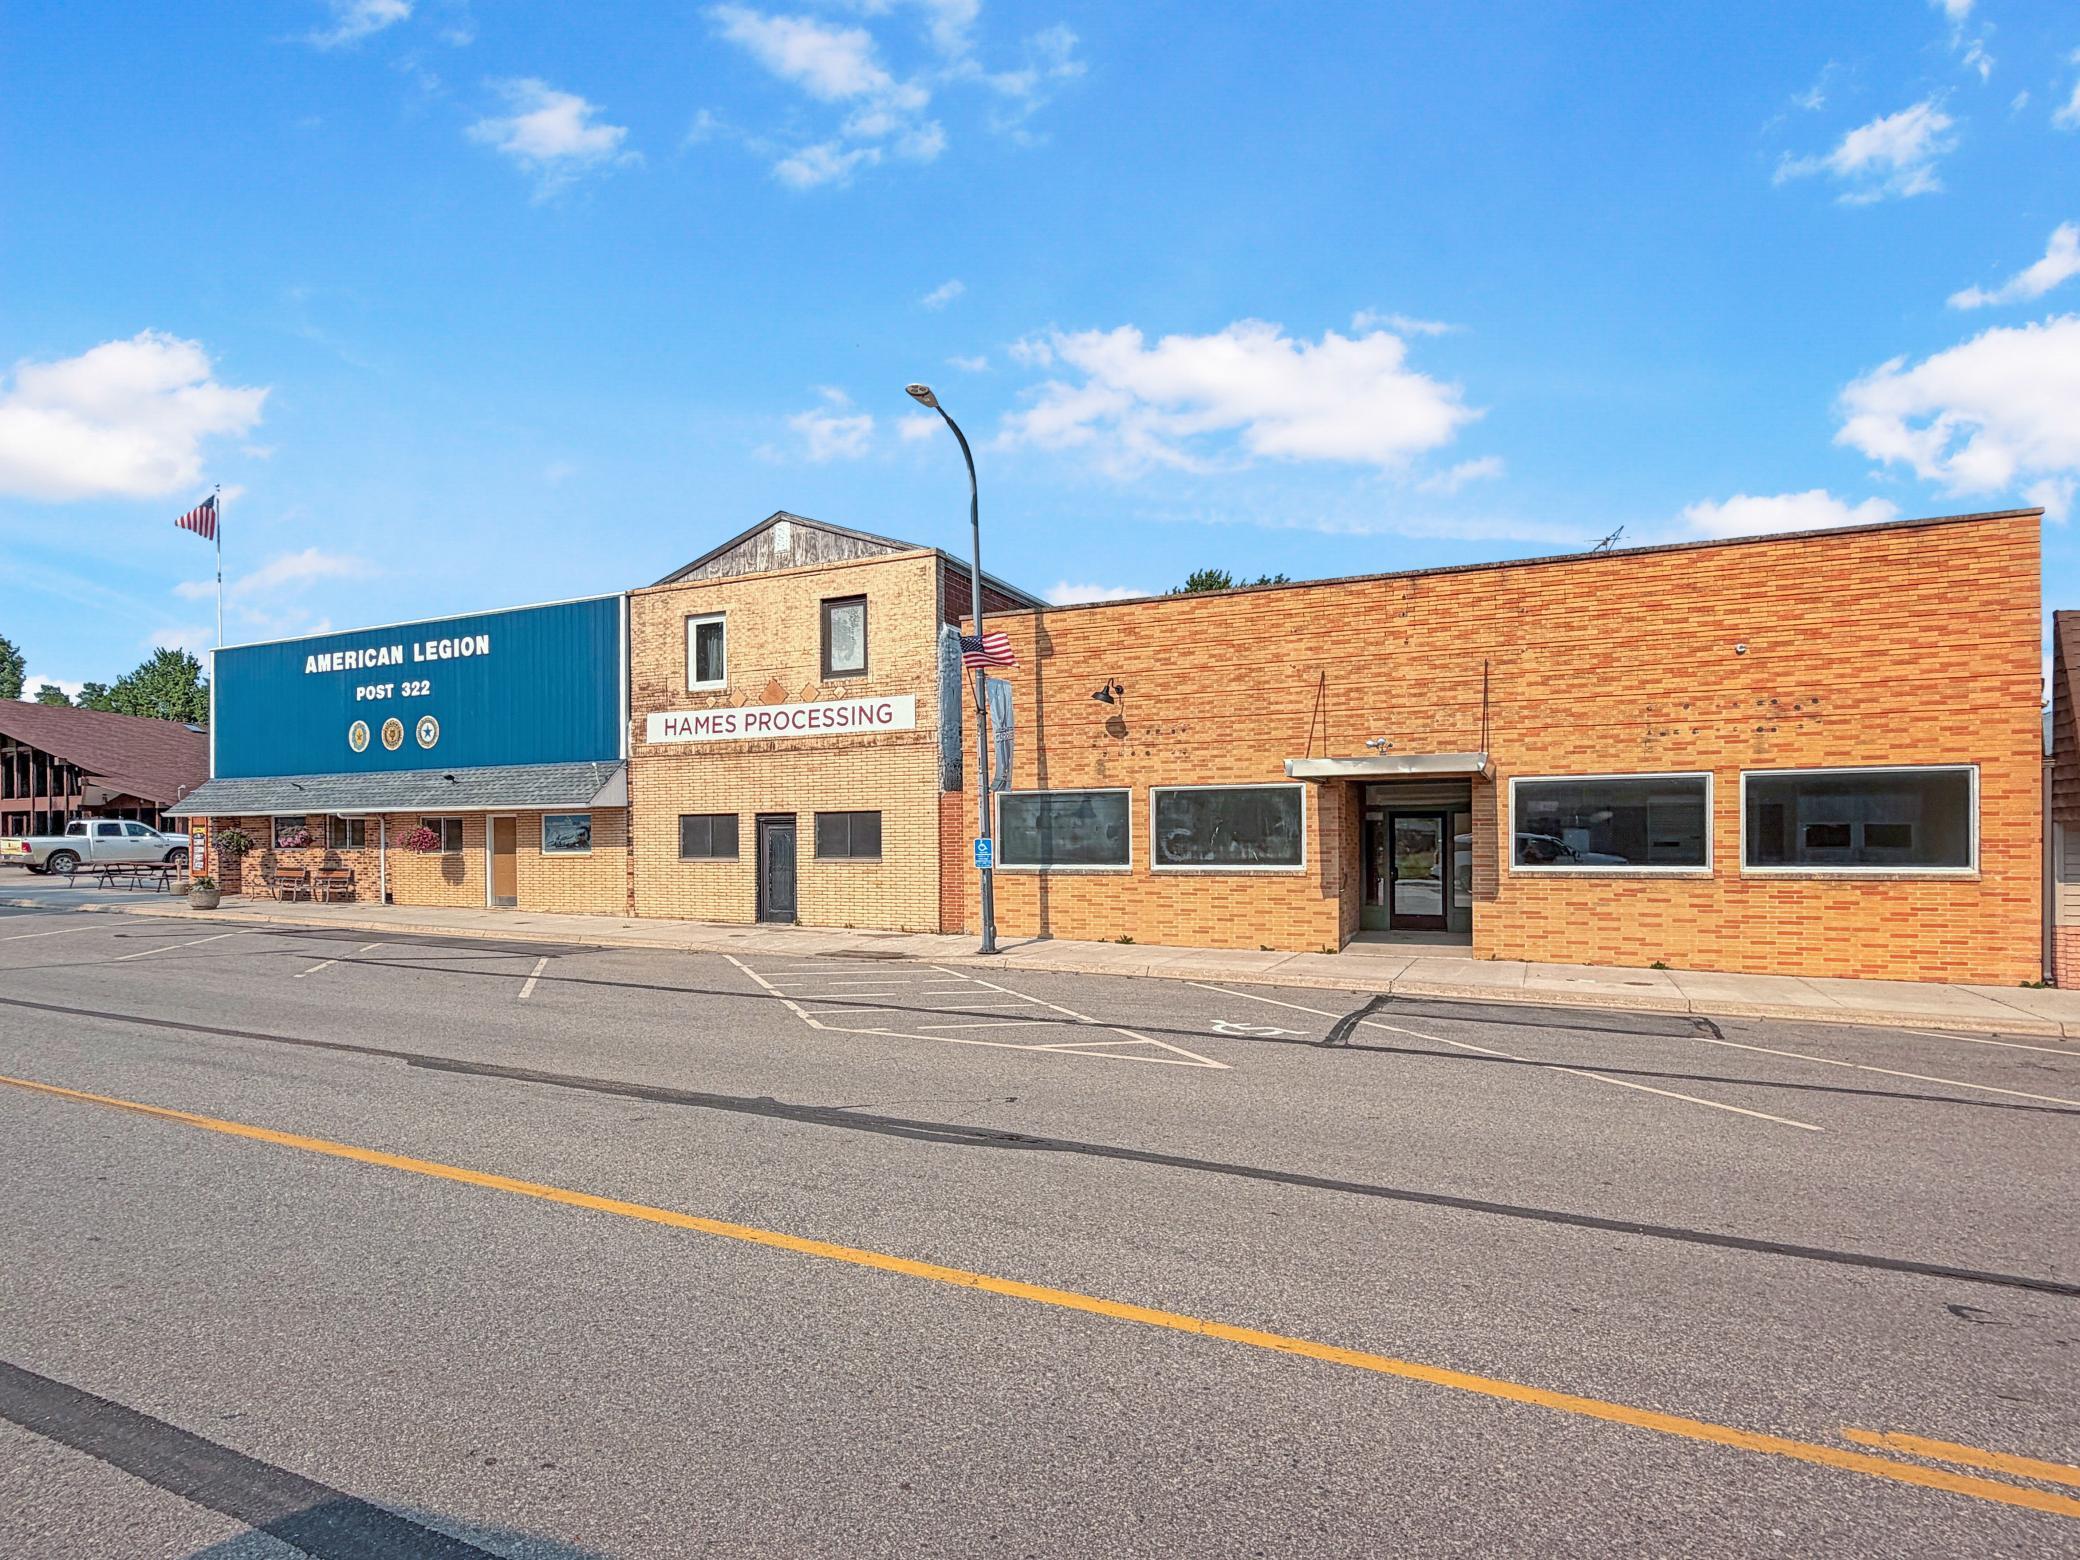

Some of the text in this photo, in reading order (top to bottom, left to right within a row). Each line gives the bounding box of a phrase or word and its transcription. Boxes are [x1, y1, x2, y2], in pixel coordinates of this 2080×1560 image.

[305, 635, 490, 674] AMERICAN LEGION
[356, 680, 431, 701] POST 322
[664, 703, 893, 736] HAMES PROCESSING
